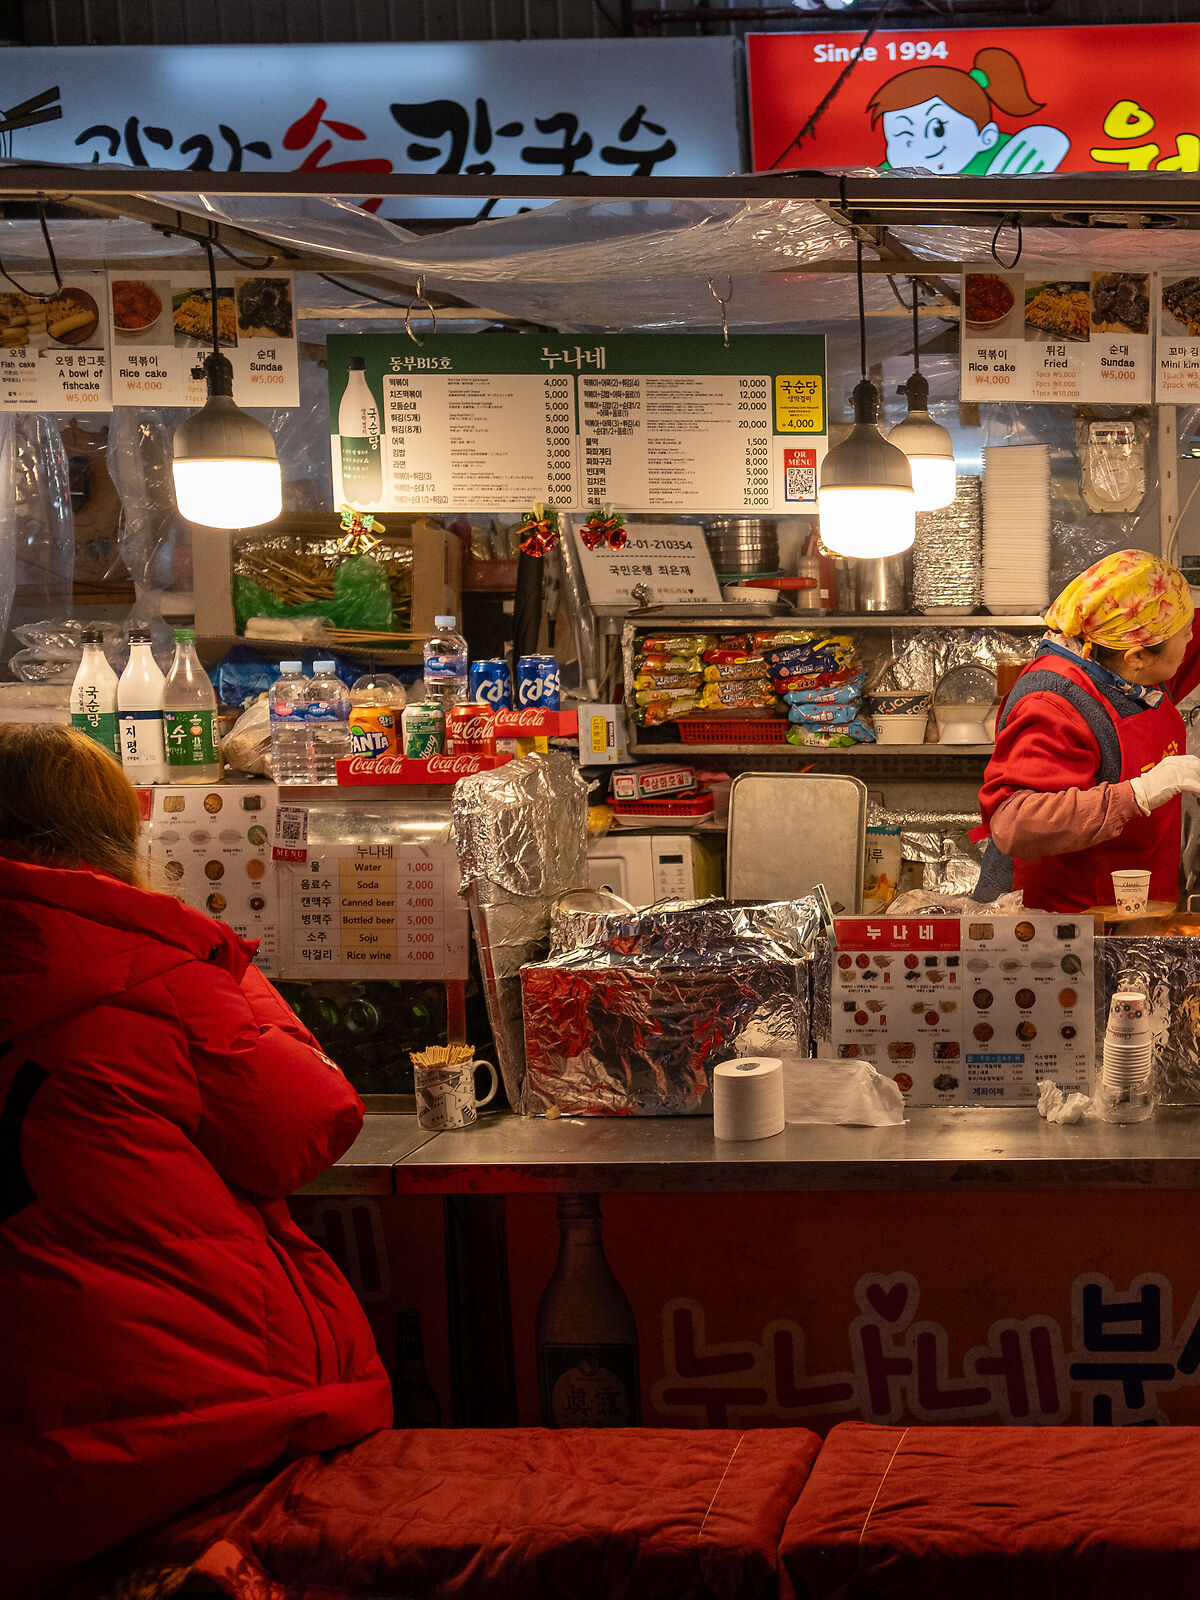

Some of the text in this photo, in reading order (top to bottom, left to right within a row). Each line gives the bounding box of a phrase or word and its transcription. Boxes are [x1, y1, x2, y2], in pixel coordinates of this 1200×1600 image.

[814, 40, 949, 63] Since 1994
[256, 349, 276, 361] 순대
[978, 350, 1007, 360] 떡볶이
[1046, 345, 1067, 356] 튀김
[1109, 345, 1129, 356] 순대
[128, 355, 159, 367] 떡볶이
[540, 346, 606, 370] 누나네
[1101, 358, 1135, 368] Sundae
[250, 362, 283, 372] Sundae
[389, 356, 453, 372] 동부B15호
[968, 363, 1016, 372] Rice cake
[1044, 359, 1068, 368] Fried
[1161, 361, 1180, 369] Mini
[58, 369, 103, 378] A bowl of
[119, 369, 167, 379] Rice cake
[62, 381, 100, 391] fishcake
[543, 378, 568, 389] 4,000
[739, 380, 766, 388] 10,000
[780, 380, 817, 394] 국순당
[544, 390, 569, 400] 5,000
[740, 391, 766, 399] 12,000
[544, 402, 569, 412] 5,000
[738, 403, 766, 411] 20,000
[545, 414, 569, 424] 5,000
[739, 421, 767, 429] 20,000
[787, 420, 814, 429] 4,000
[545, 425, 570, 435] 8,000
[546, 437, 570, 447] 5,000
[747, 439, 767, 447] 1,500
[546, 449, 571, 459] 3,000
[746, 449, 767, 457] 5,000
[547, 460, 571, 470] 5,000
[746, 458, 768, 466] 8,000
[547, 472, 571, 482] 6,000
[746, 468, 768, 477] 5,000
[747, 478, 768, 486] 7,000
[547, 484, 572, 494] 6,000
[744, 488, 768, 496] 15,000
[548, 495, 572, 505] 8,000
[744, 498, 768, 506] 21,000
[609, 565, 691, 576] 국민은행 최은재
[85, 686, 101, 728] 국순당
[126, 725, 137, 753] 지평
[350, 756, 402, 775] Coca-Cola
[426, 754, 480, 774] Coca-Cola
[357, 845, 393, 859] 누나네
[355, 863, 433, 872] Water 1,000
[301, 879, 433, 891] 음료수 Soda 2,000
[301, 896, 433, 908] 캔맥주 Canned beer 4,000
[302, 914, 434, 925] 병맥주 Bottled beer 5,000
[307, 932, 434, 943] 소주 Soju 5,000
[867, 925, 934, 940] 누 나 네
[302, 949, 434, 961] 막걸리 Rice wine 4,000
[656, 1302, 1062, 1428] 누나네
